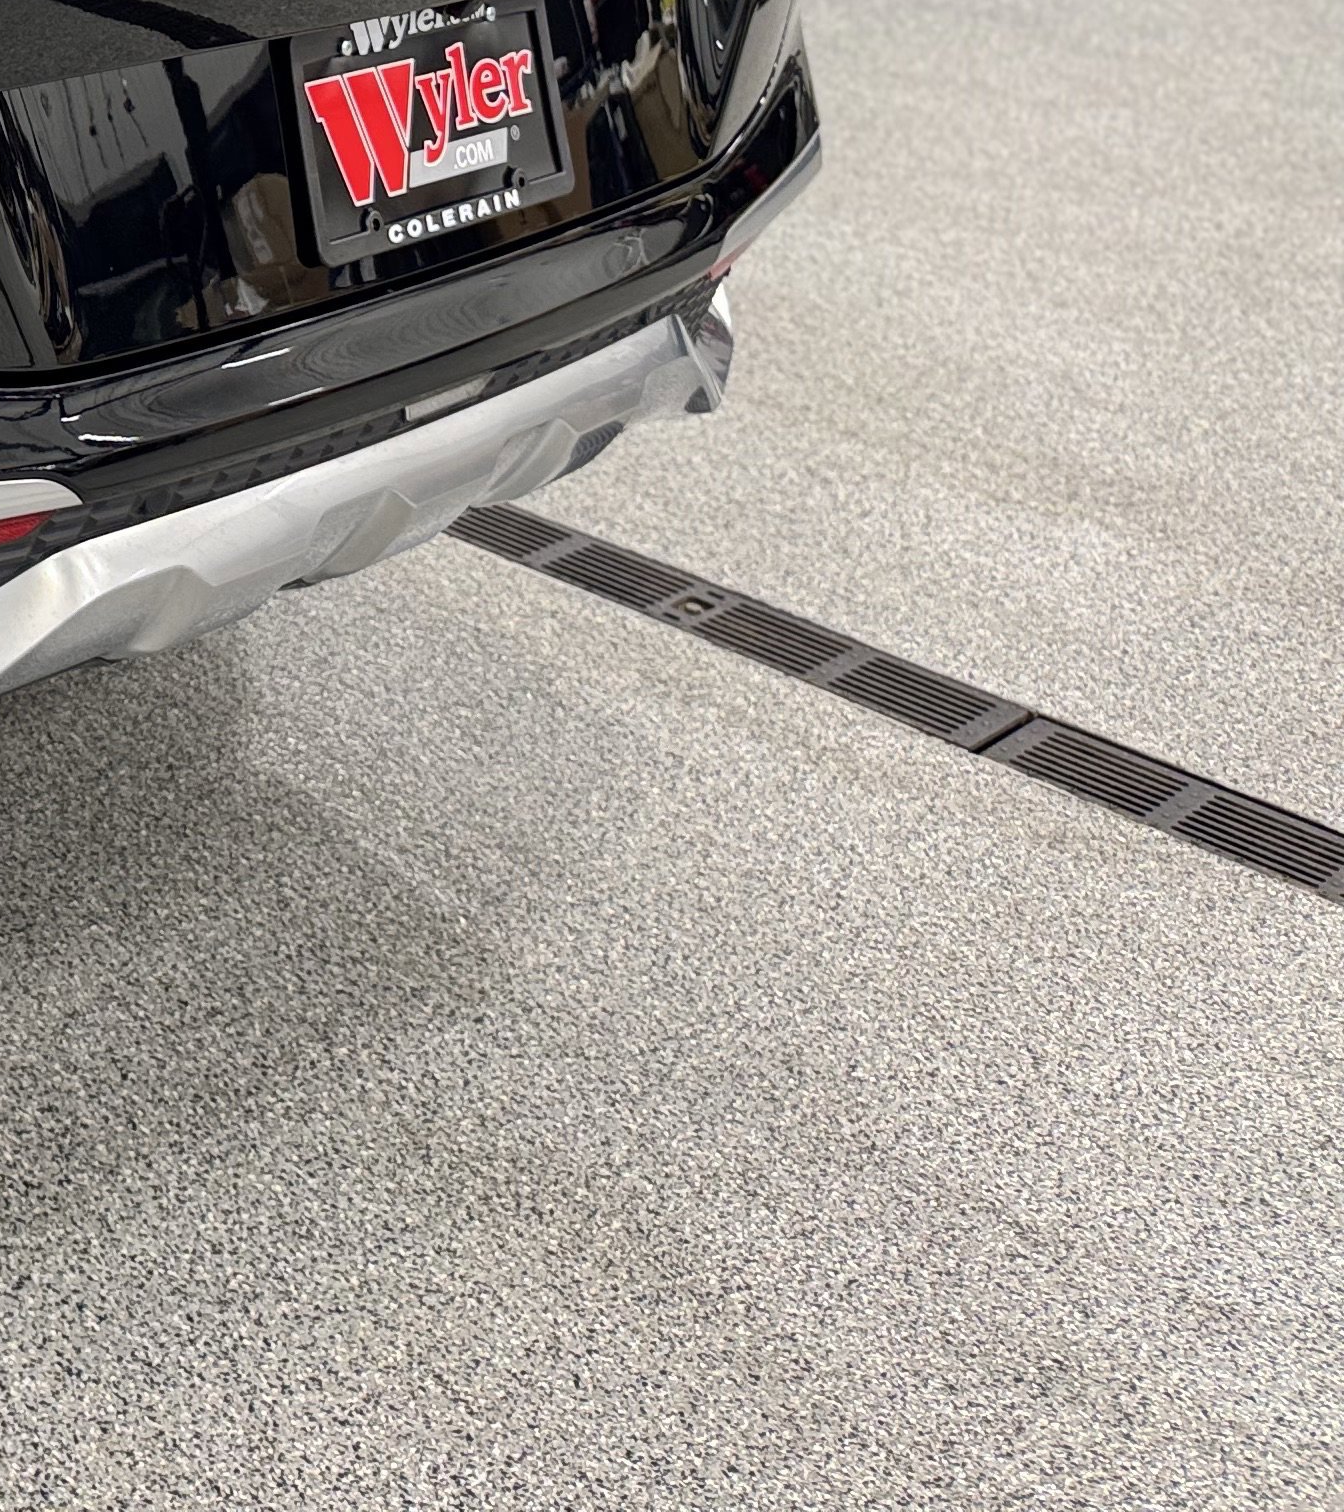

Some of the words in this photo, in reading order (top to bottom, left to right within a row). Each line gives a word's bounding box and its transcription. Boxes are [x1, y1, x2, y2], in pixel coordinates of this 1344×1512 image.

[304, 42, 534, 208] Wyler
[454, 138, 495, 170] .COM
[387, 188, 521, 244] COLERAIN
